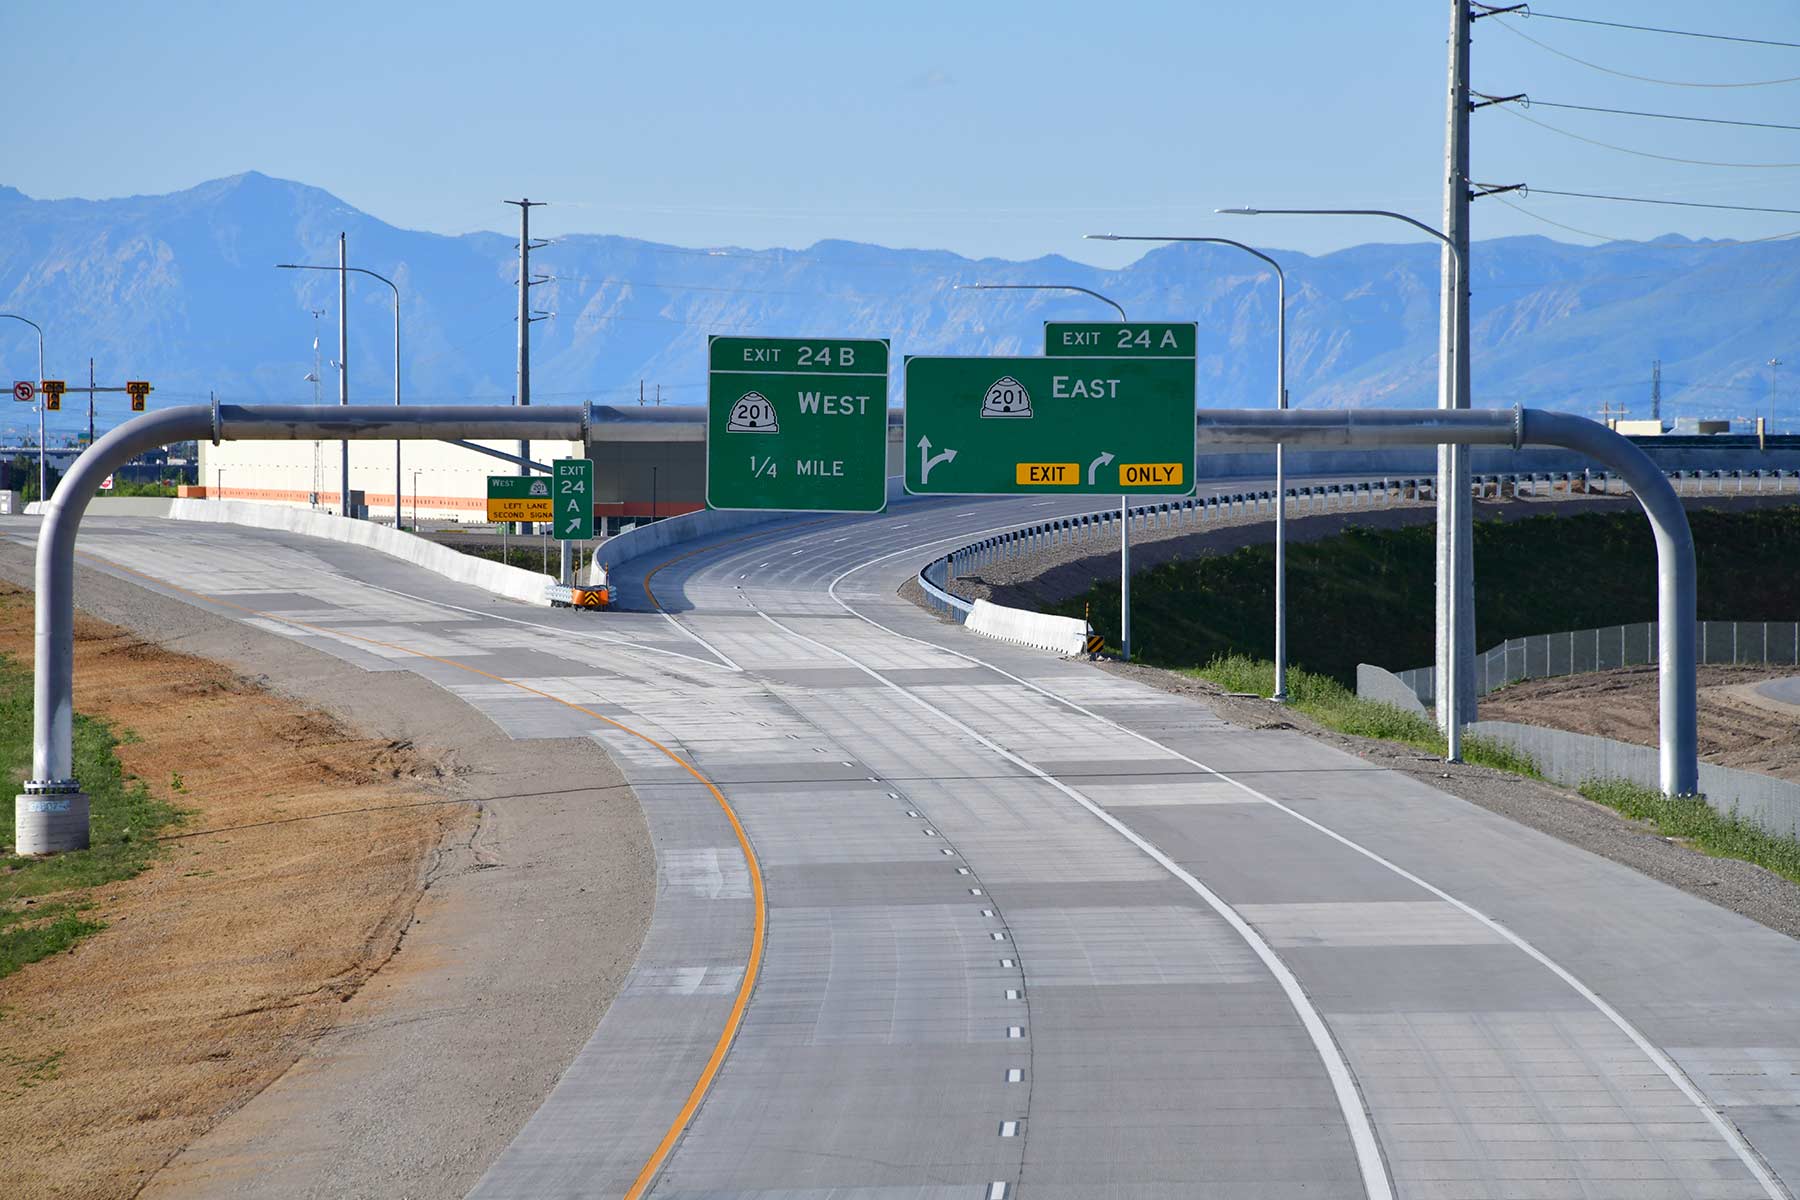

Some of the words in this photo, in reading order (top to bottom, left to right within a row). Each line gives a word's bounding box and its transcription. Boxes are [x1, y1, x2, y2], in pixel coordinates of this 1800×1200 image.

[1063, 332, 1101, 346] EXIT
[1117, 329, 1152, 349] 24
[1160, 329, 1178, 349] A
[743, 348, 781, 362] EXIT
[797, 346, 832, 366] 24
[839, 347, 855, 367] B
[1052, 375, 1121, 399] EAST
[797, 391, 870, 415] WEST
[992, 389, 1023, 405] 201
[738, 404, 769, 420] 201
[560, 466, 585, 476] EXIT
[796, 460, 844, 477] MILE
[1030, 467, 1066, 482] EXIT
[1126, 467, 1175, 483] ONLY
[492, 479, 514, 487] WEST
[561, 480, 585, 494] 24
[567, 499, 580, 513] A
